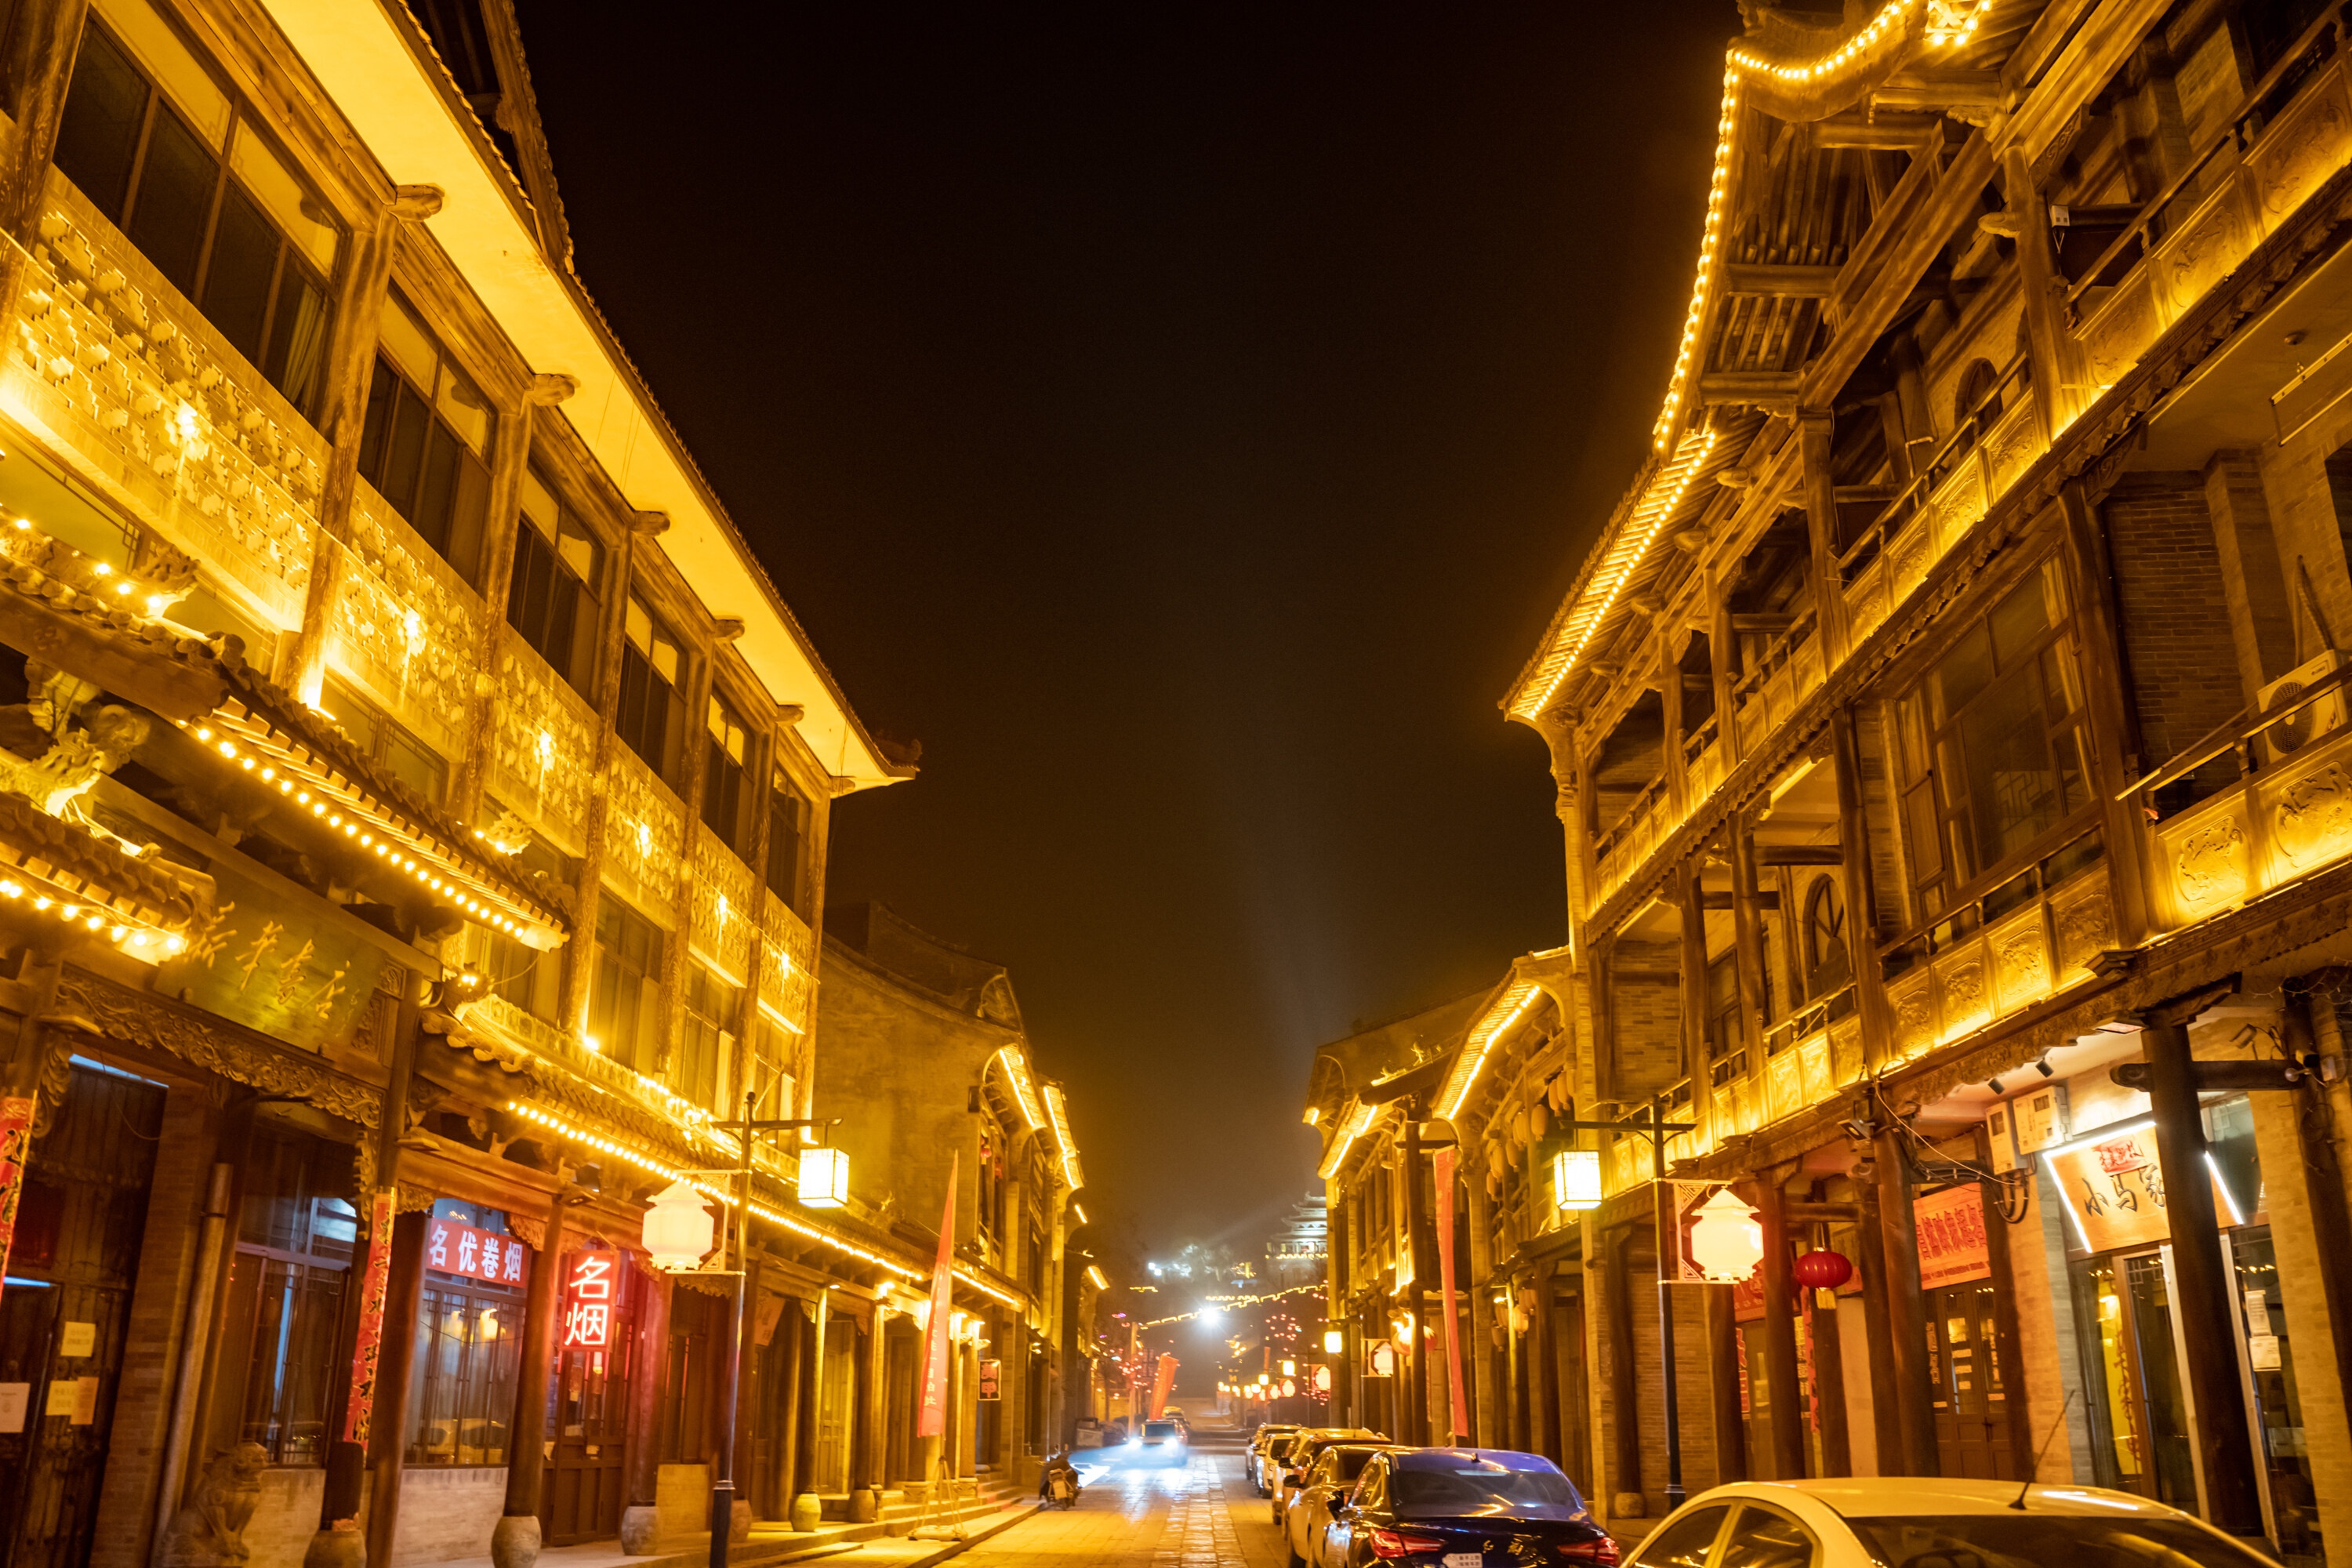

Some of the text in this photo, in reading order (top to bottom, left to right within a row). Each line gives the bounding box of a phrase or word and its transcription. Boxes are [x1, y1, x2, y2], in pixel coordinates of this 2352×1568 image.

[430, 1224, 523, 1282] 名优卷烟
[564, 1256, 611, 1346] 名烟
[981, 1362, 997, 1399] 美甲
